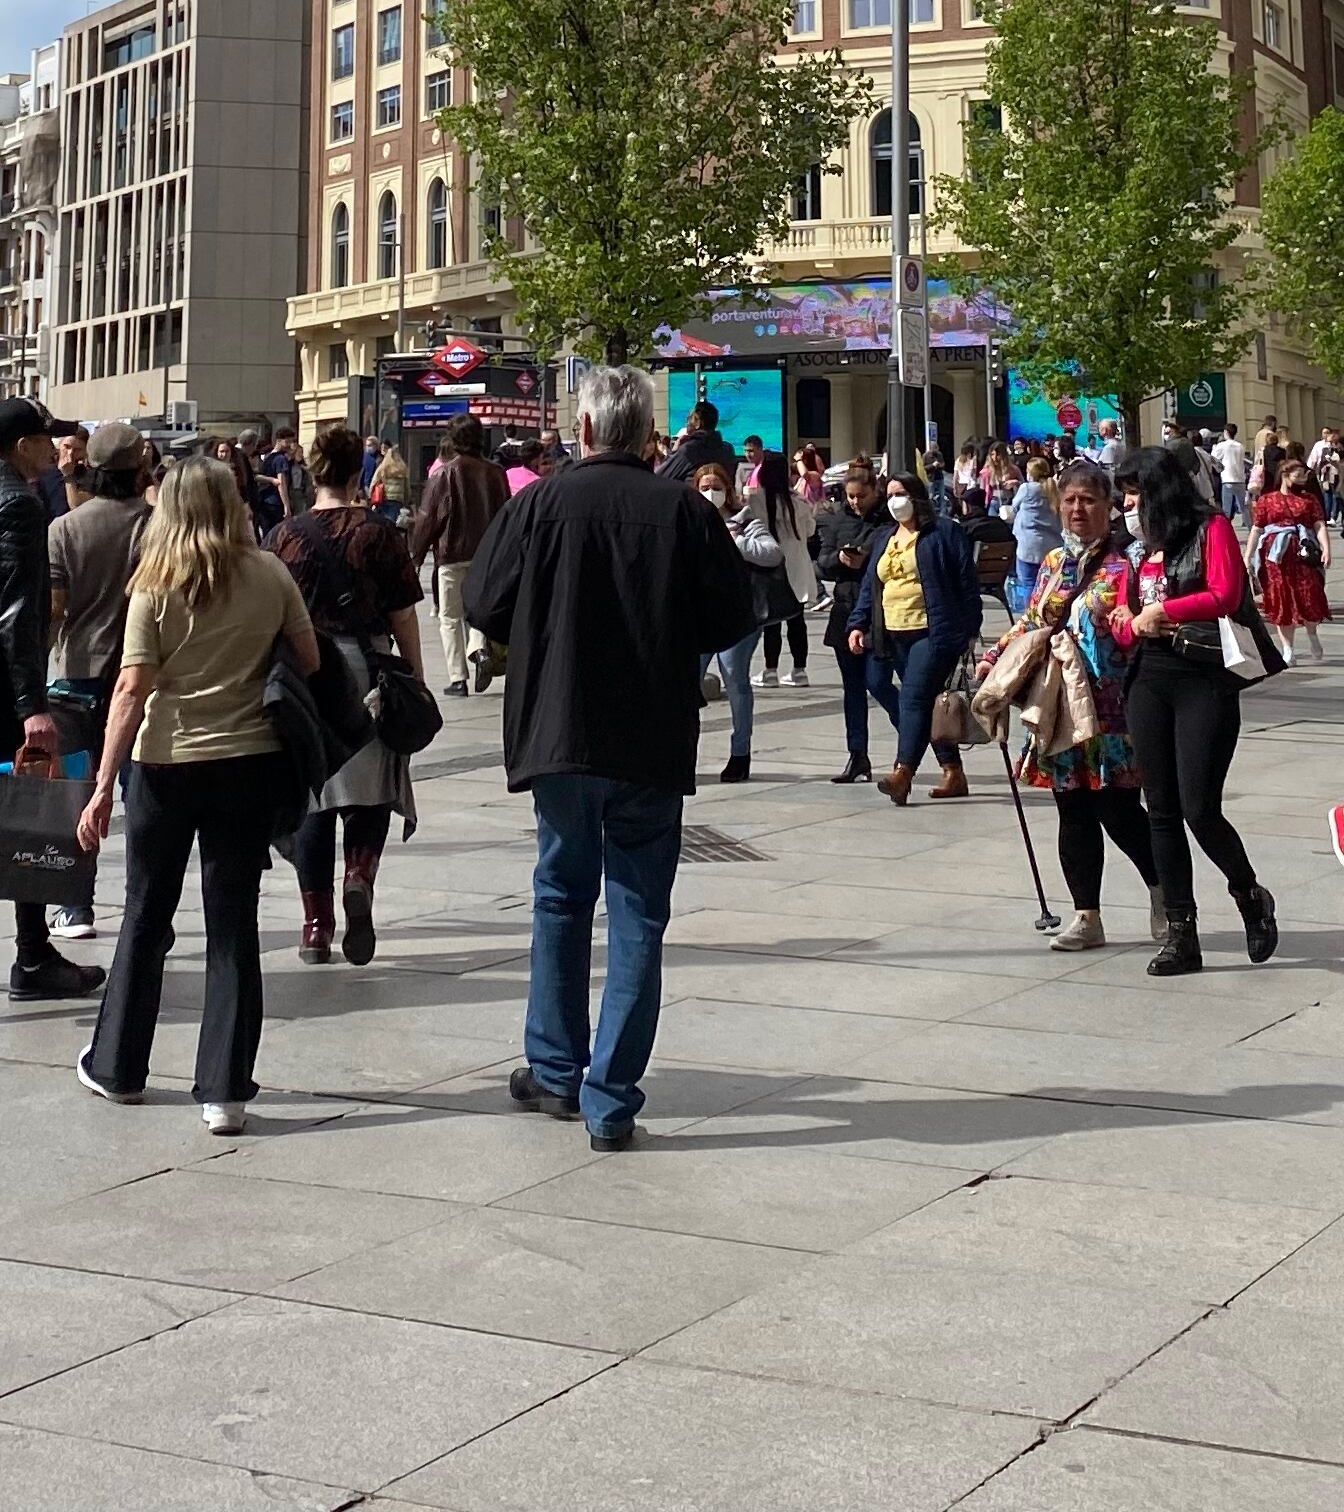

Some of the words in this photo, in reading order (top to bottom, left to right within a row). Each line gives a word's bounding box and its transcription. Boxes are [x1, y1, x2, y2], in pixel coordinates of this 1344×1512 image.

[446, 352, 470, 363] Metro
[944, 346, 986, 363] PREN
[11, 851, 76, 867] APLAUSO
